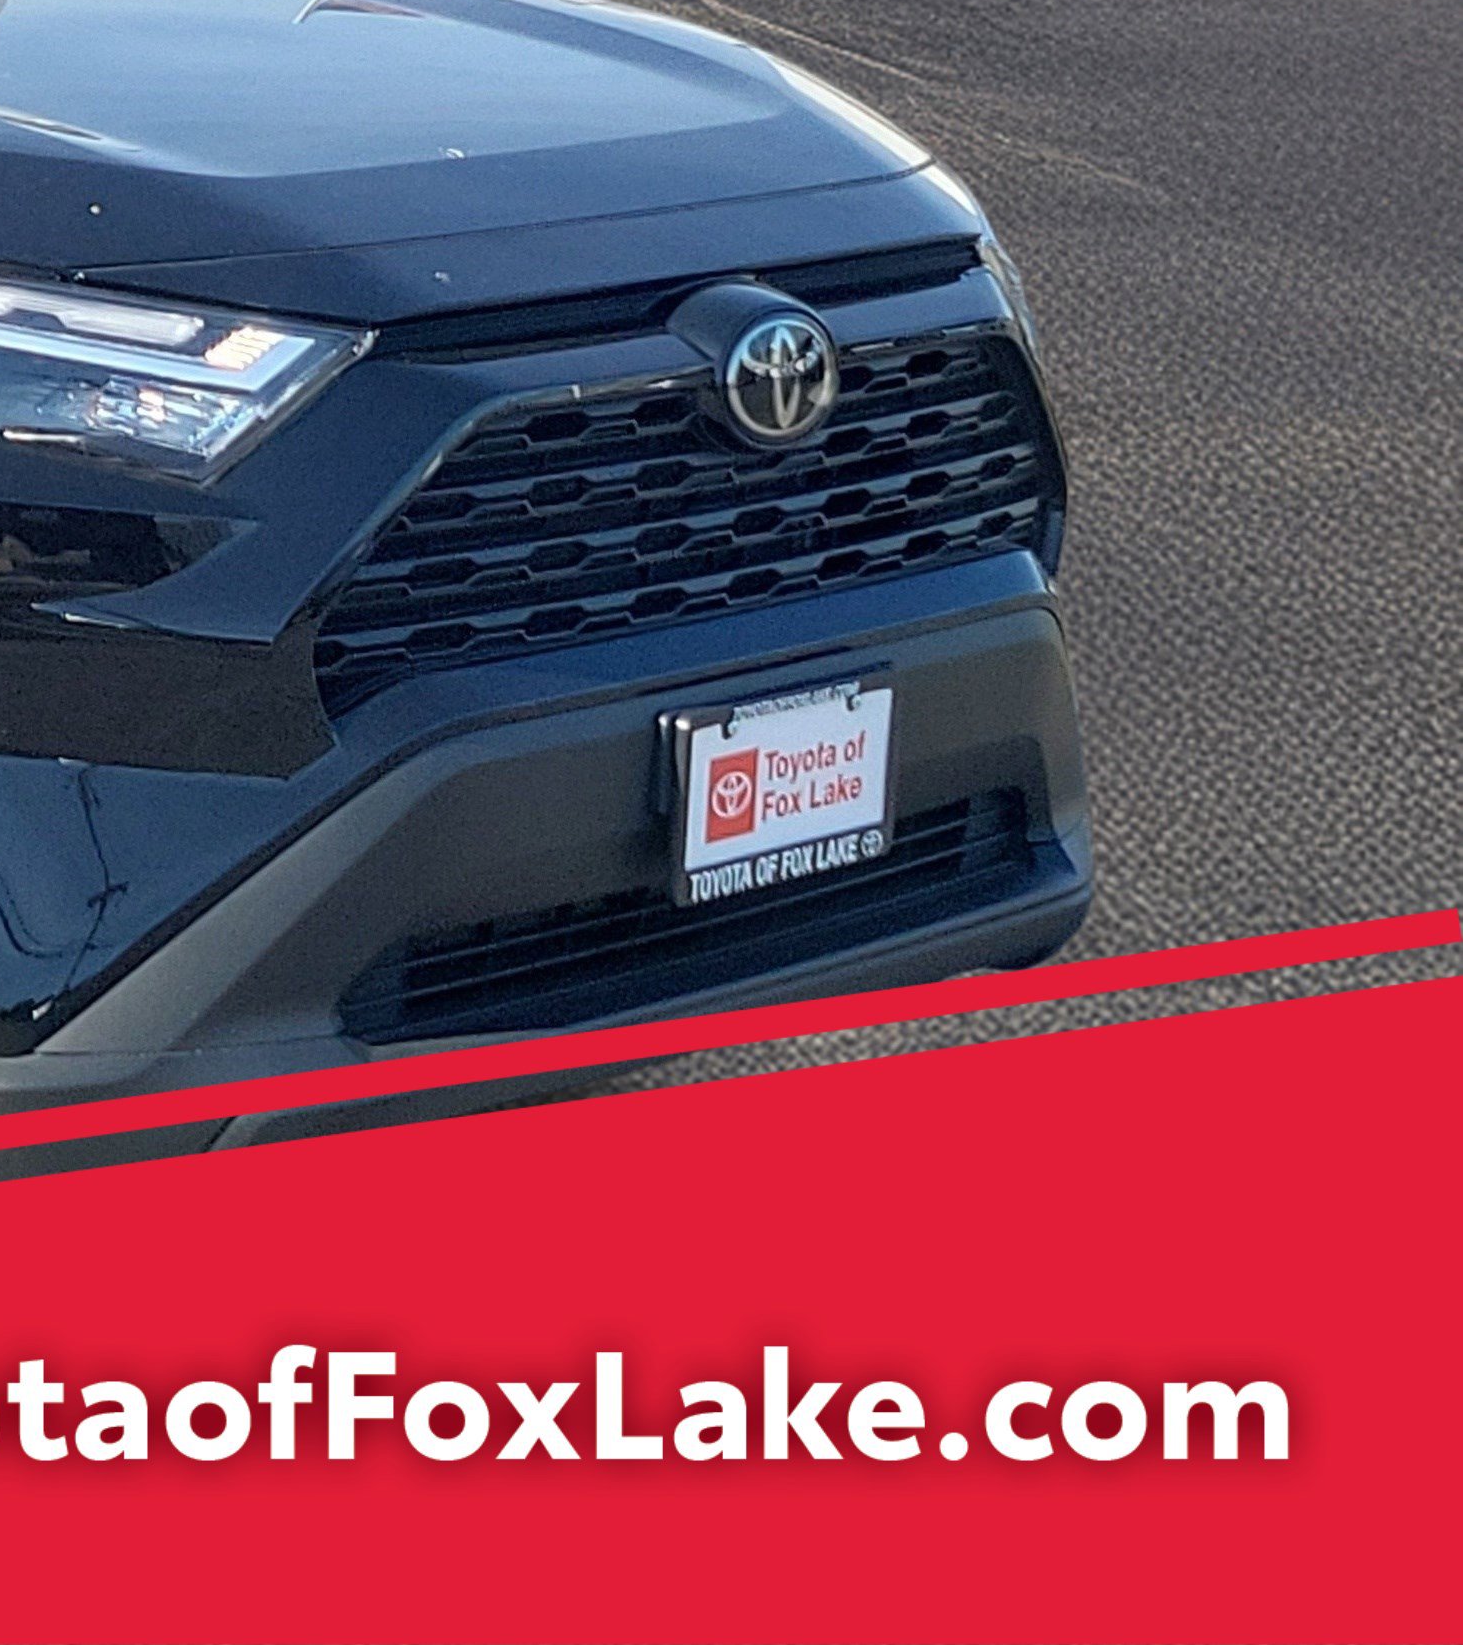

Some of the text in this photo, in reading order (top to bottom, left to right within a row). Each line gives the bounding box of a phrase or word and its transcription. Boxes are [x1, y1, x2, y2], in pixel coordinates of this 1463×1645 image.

[765, 729, 867, 784] Toyota of
[761, 773, 863, 822] Fox Lake
[690, 833, 861, 903] TOYOTA OF FOX LAKE
